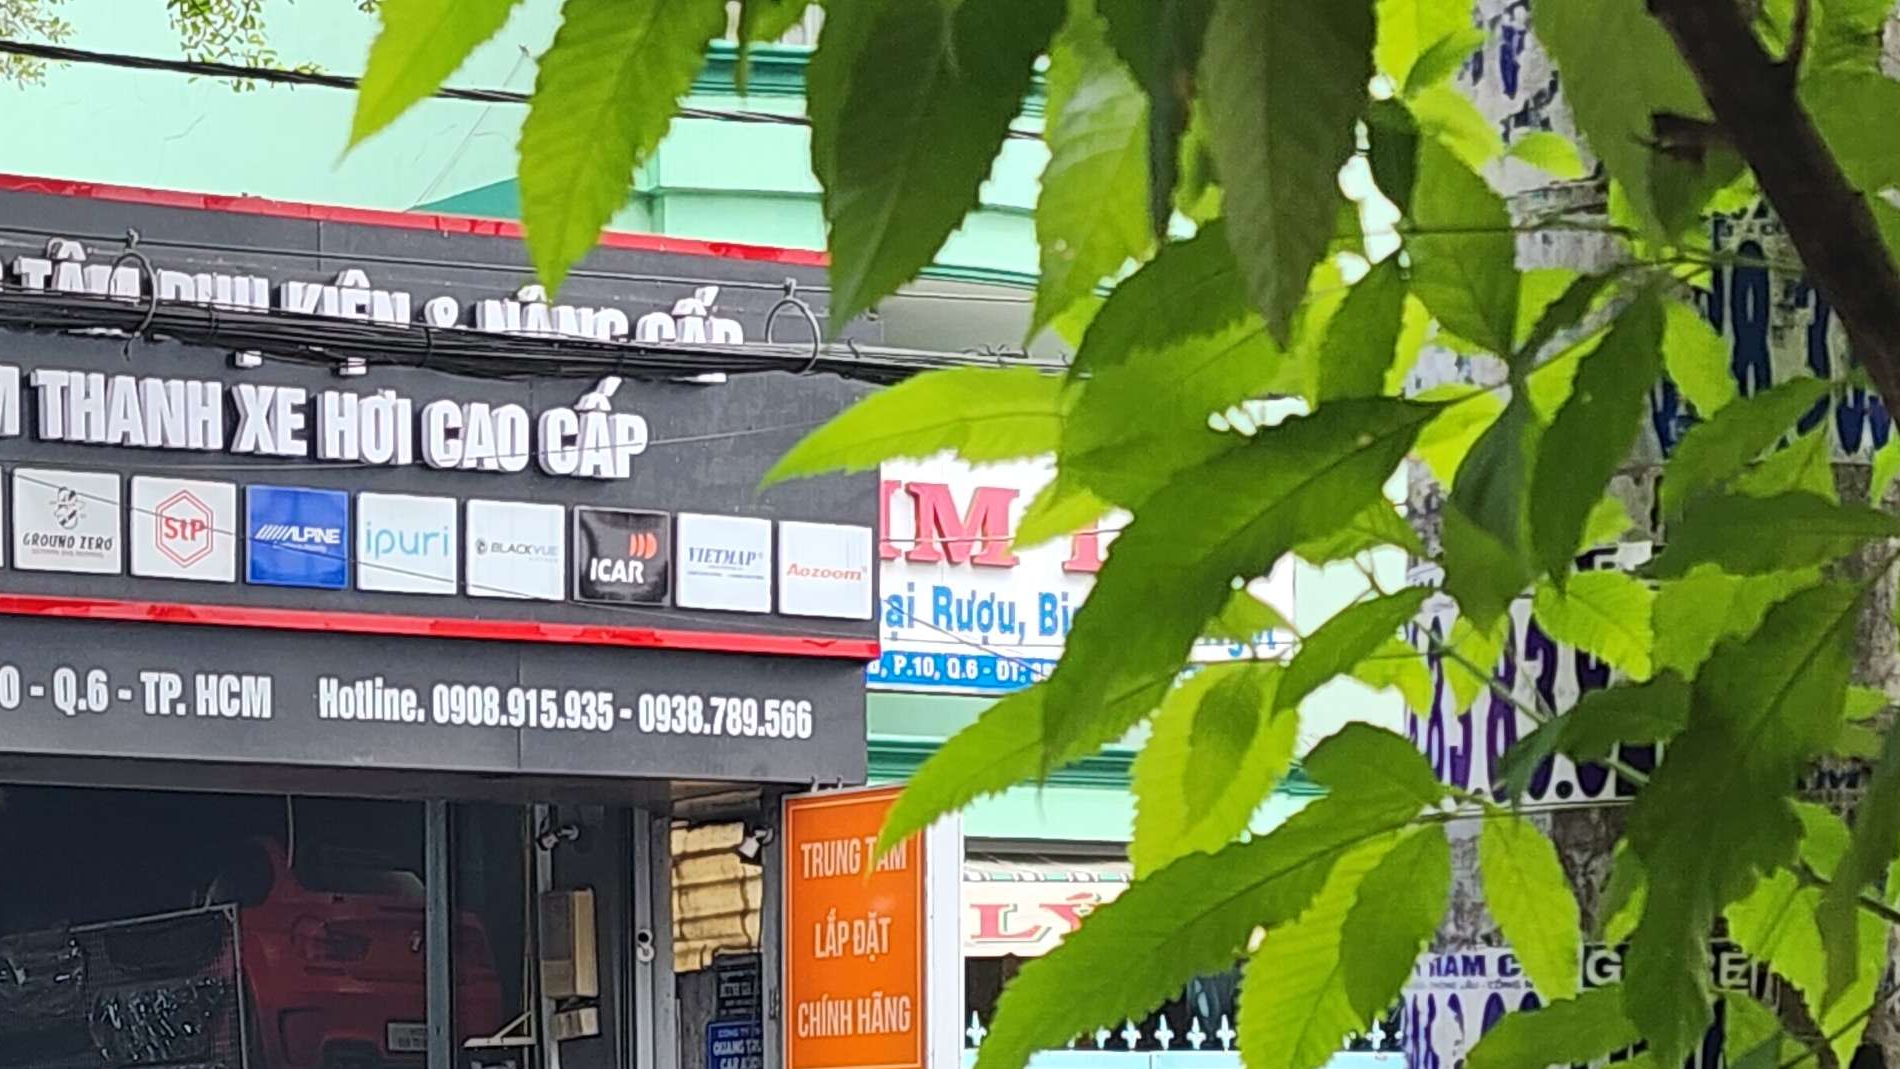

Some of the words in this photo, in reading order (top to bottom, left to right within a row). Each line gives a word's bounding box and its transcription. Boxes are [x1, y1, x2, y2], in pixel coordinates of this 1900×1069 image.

[31, 368, 222, 451] THANH
[230, 383, 307, 456] XE
[422, 399, 530, 472] CAO
[538, 376, 649, 480] CẤP
[22, 535, 75, 550] GROUND
[79, 536, 113, 551] ZERO
[268, 524, 340, 545] ALPINE
[365, 521, 449, 560] ipuri
[490, 542, 559, 556] BLACKVUE
[589, 557, 645, 584] ICAR
[688, 546, 756, 567] VIETMAP
[786, 562, 862, 581] Aozoom
[883, 581, 915, 641] ại
[1038, 591, 1076, 637] Bi
[53, 667, 108, 715] Q.6
[318, 676, 425, 723] Hotline.
[432, 684, 613, 732] 0908.915.935
[638, 693, 812, 739] 0938.789.566
[800, 838, 861, 879] TRUNG
[814, 906, 849, 959] LẮP
[853, 911, 892, 962] ĐẶT
[797, 992, 853, 1038] CHÍNH
[857, 990, 911, 1034] HÃNG
